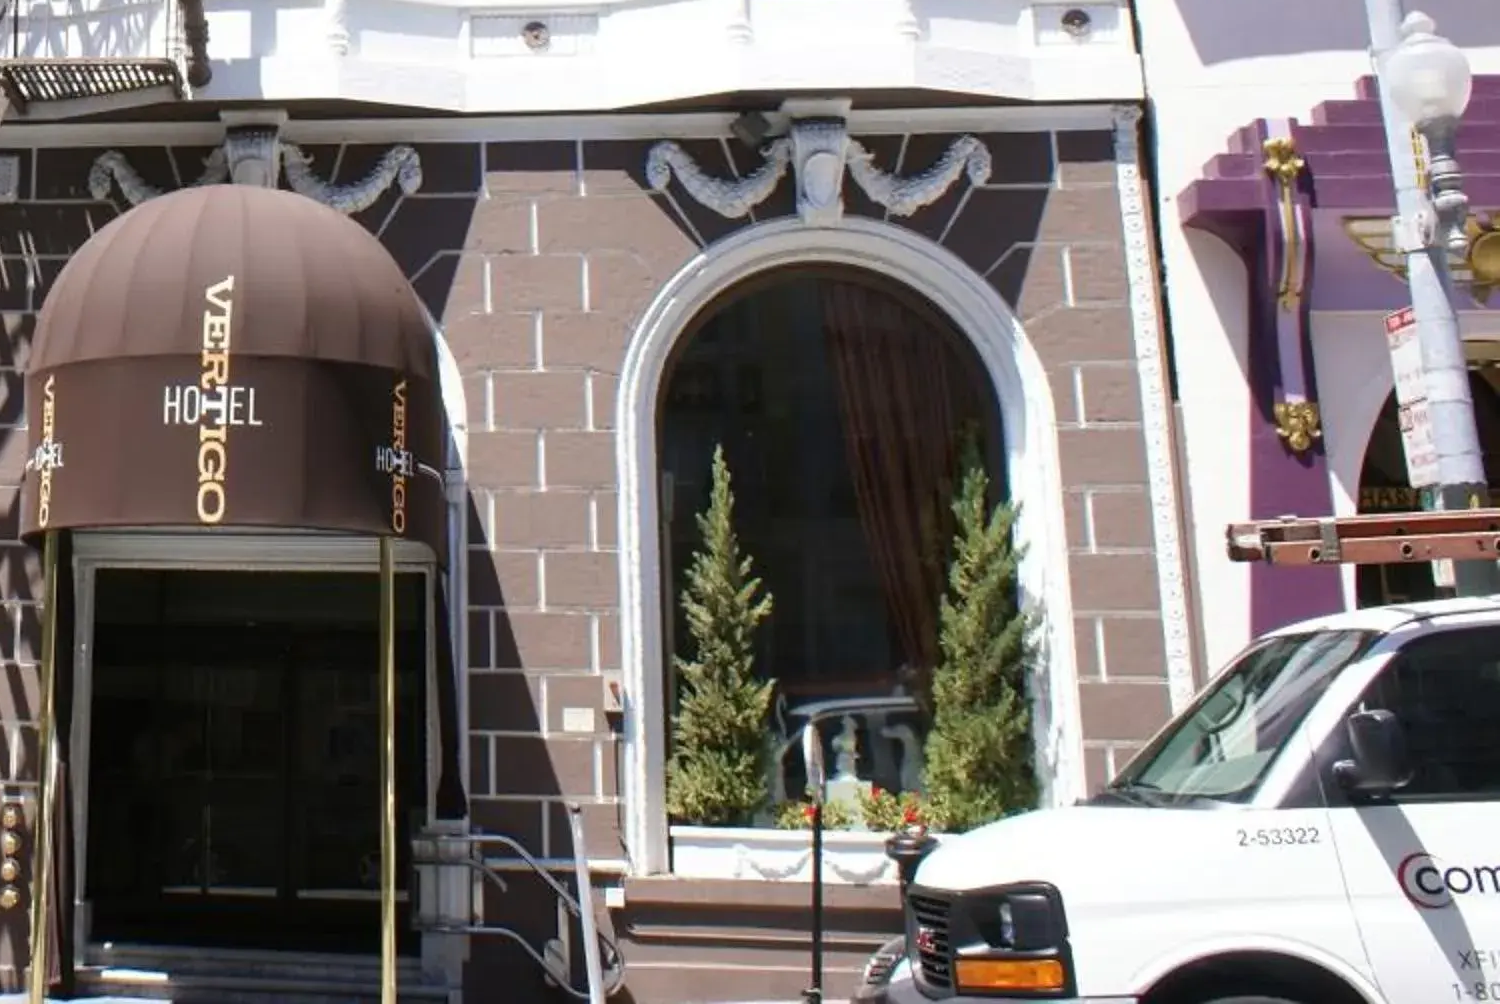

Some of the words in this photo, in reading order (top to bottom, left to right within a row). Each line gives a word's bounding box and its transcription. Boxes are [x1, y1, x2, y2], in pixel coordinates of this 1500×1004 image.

[163, 385, 263, 425] HOTEL
[197, 275, 234, 524] VERTIGO
[35, 443, 64, 471] OTEL
[375, 446, 414, 476] HOTEL
[392, 380, 406, 533] VERTIGO
[1237, 827, 1321, 846] 2-53322
